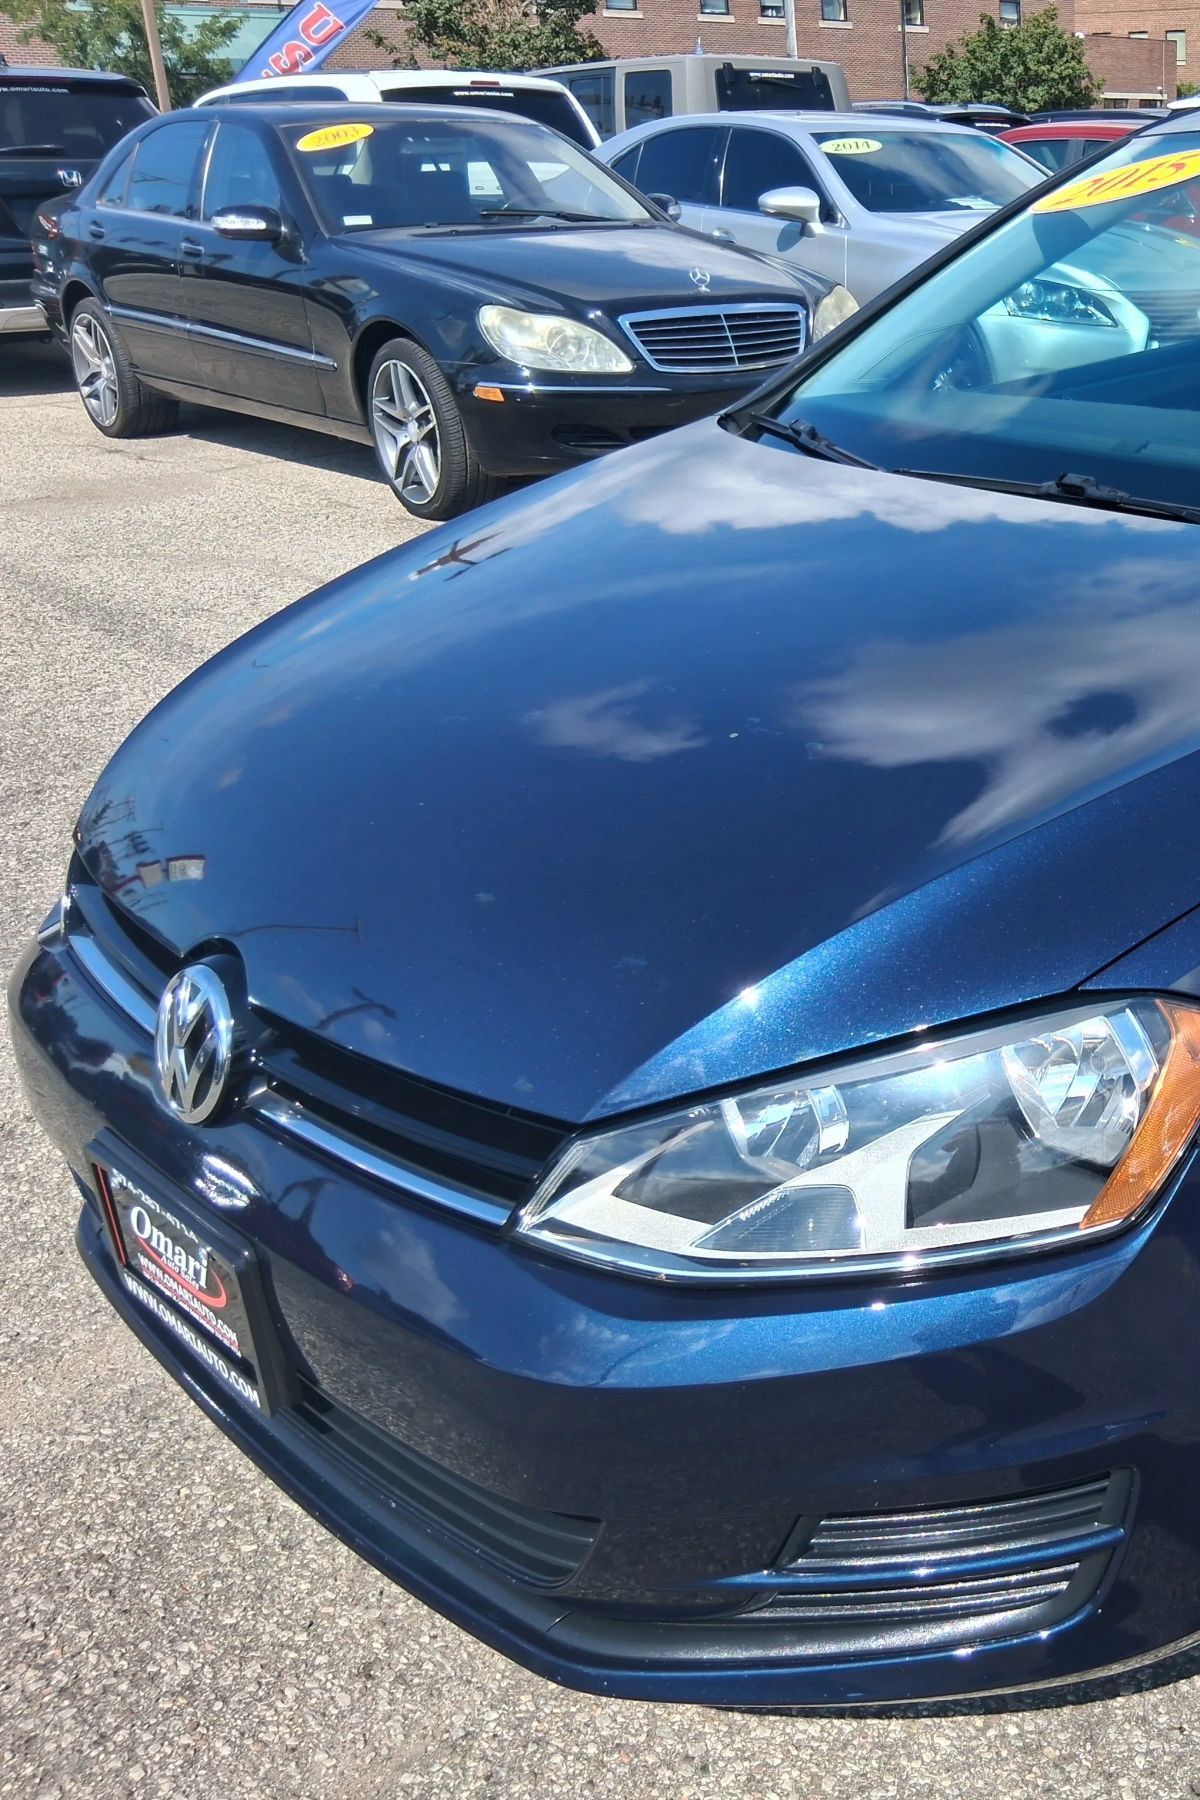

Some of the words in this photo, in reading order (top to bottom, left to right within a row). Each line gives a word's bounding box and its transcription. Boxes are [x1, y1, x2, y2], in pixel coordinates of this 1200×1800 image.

[262, 2, 346, 78] US
[831, 140, 871, 152] 2014
[130, 1206, 209, 1289] Omari
[122, 1271, 261, 1409] WWW.OMARIAUTO.COM
